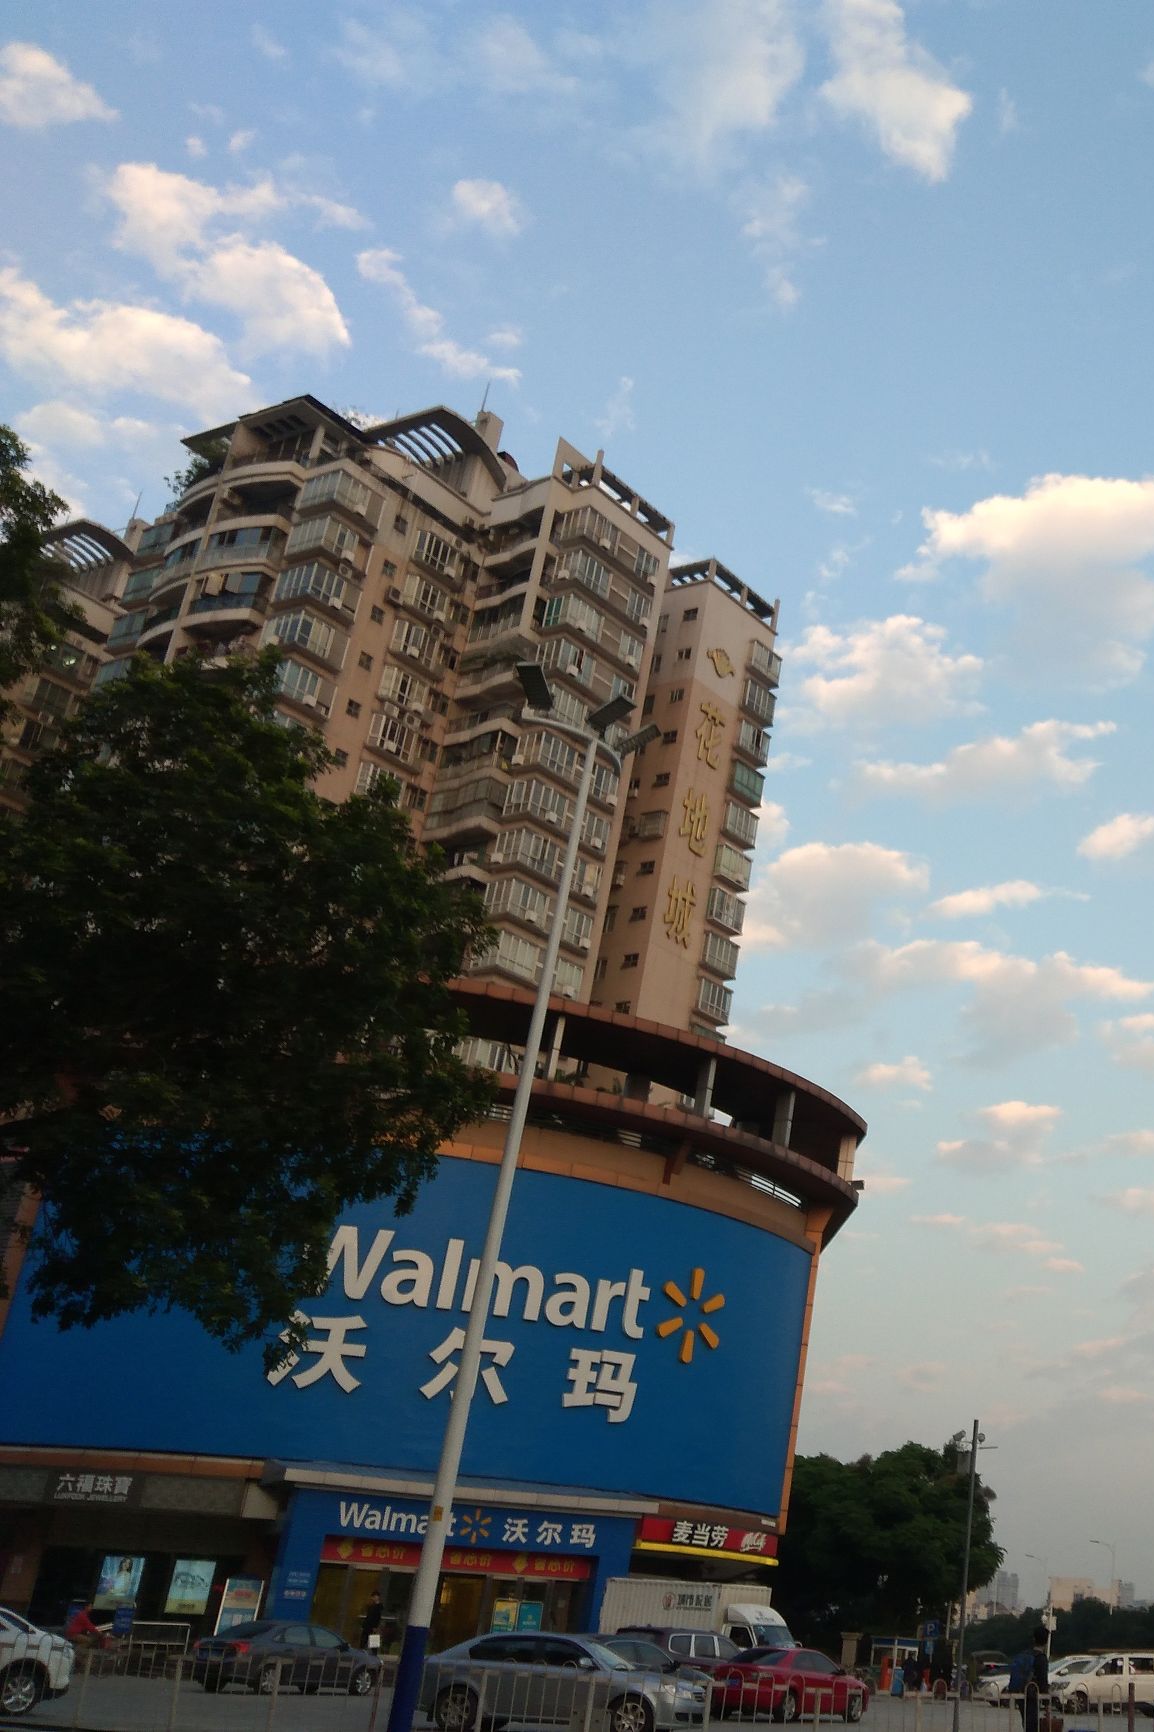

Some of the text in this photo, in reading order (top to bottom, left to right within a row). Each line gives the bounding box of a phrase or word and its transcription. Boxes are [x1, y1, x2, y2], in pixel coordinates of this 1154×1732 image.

[664, 702, 726, 950] 花地城
[303, 1224, 651, 1339] Walmart
[267, 1309, 638, 1423] 沃尔玛
[339, 1501, 457, 1537] Walmat
[501, 1518, 597, 1549] 沃尔玛
[671, 1520, 729, 1548] 麦当劳
